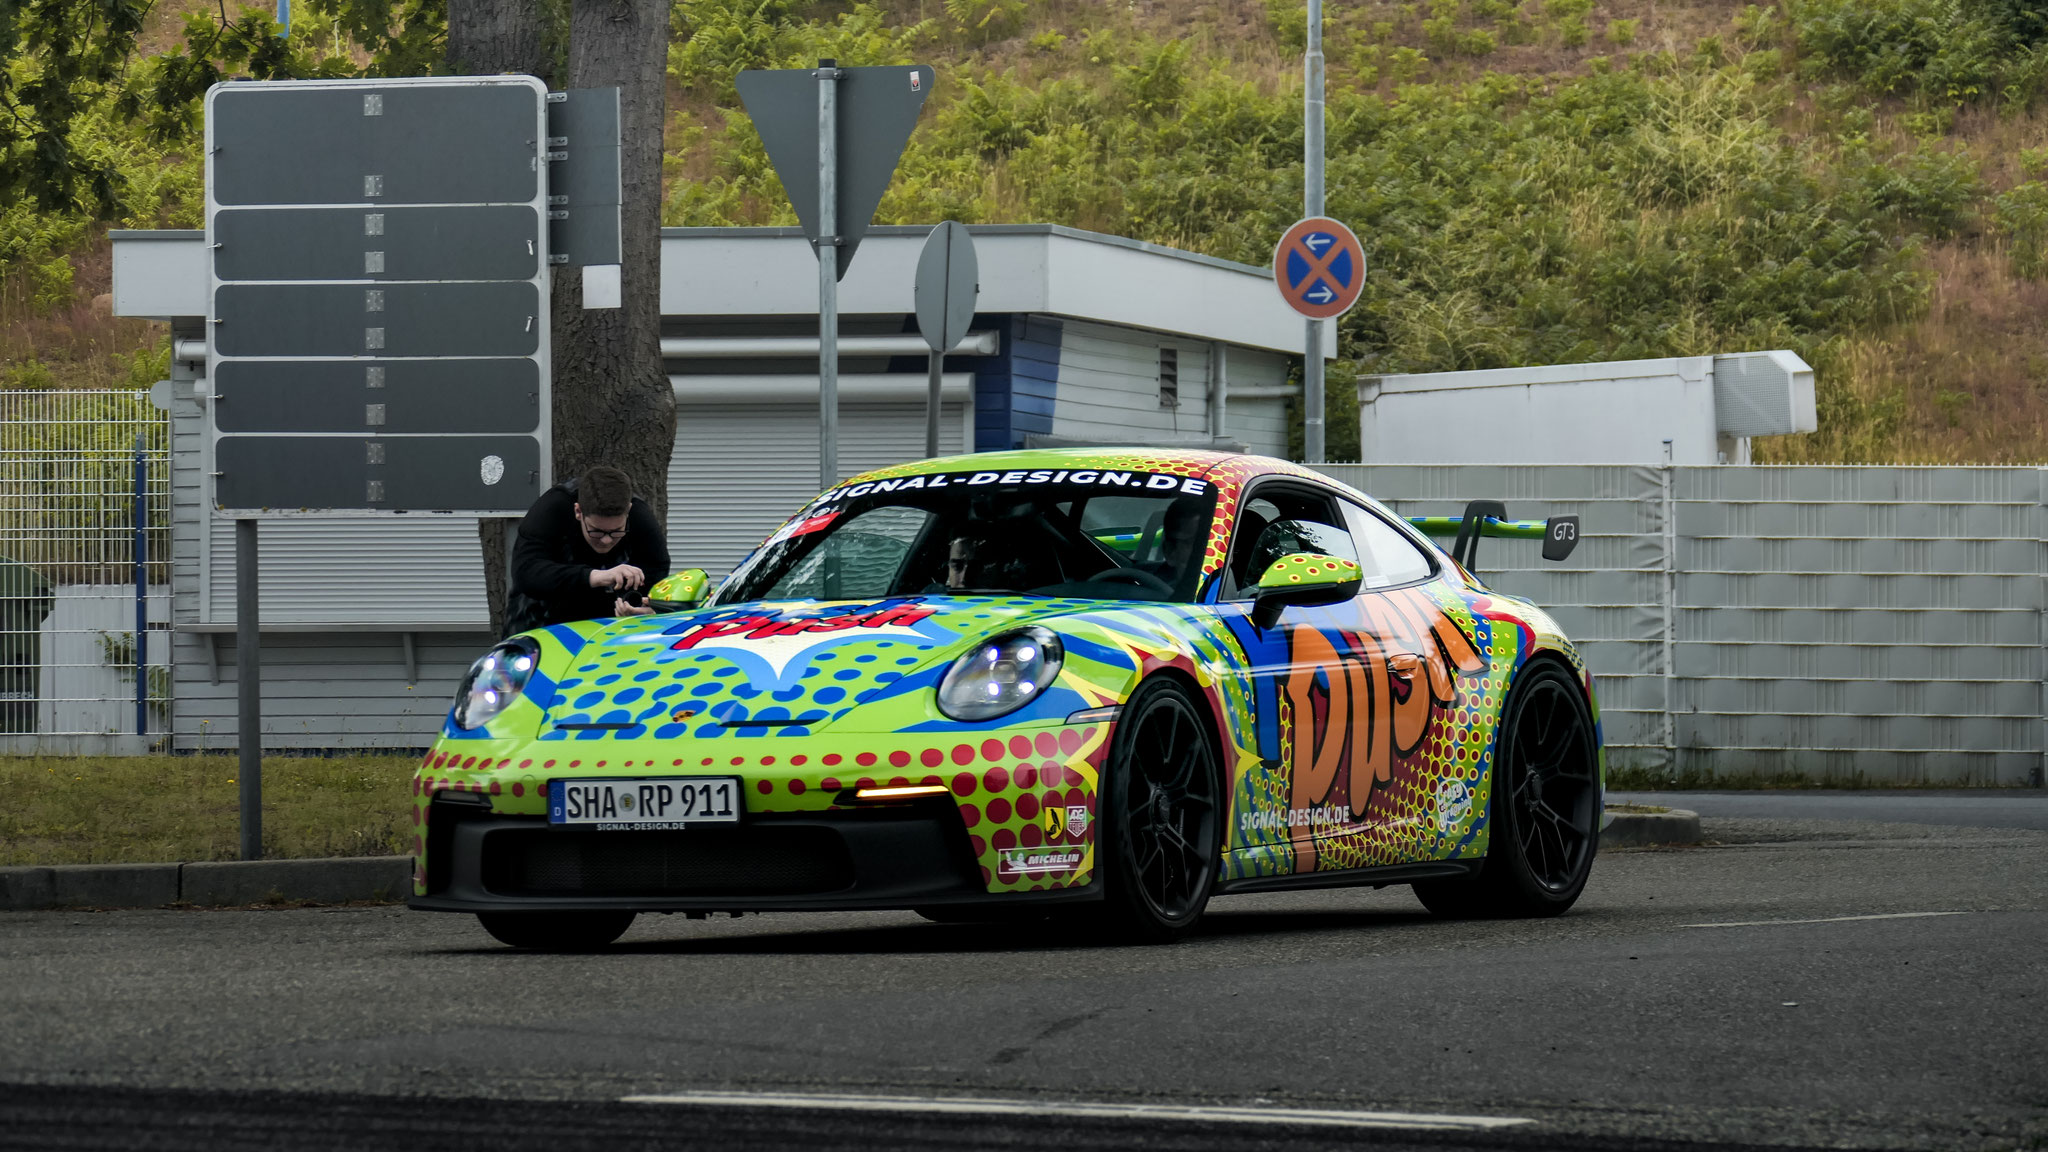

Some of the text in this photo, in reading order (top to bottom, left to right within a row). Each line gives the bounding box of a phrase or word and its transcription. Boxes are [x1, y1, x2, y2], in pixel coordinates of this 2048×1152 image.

[811, 470, 1208, 507] SIGNAL-DESIGN.DE
[1553, 522, 1575, 541] GT3
[567, 783, 733, 818] SHA RP 911
[553, 806, 562, 817] D
[1240, 805, 1350, 831] SIGNAL-DESIGN.DE
[596, 822, 686, 831] SIGNAL-DESIGN.DE
[1028, 853, 1080, 865] MICHELIN
